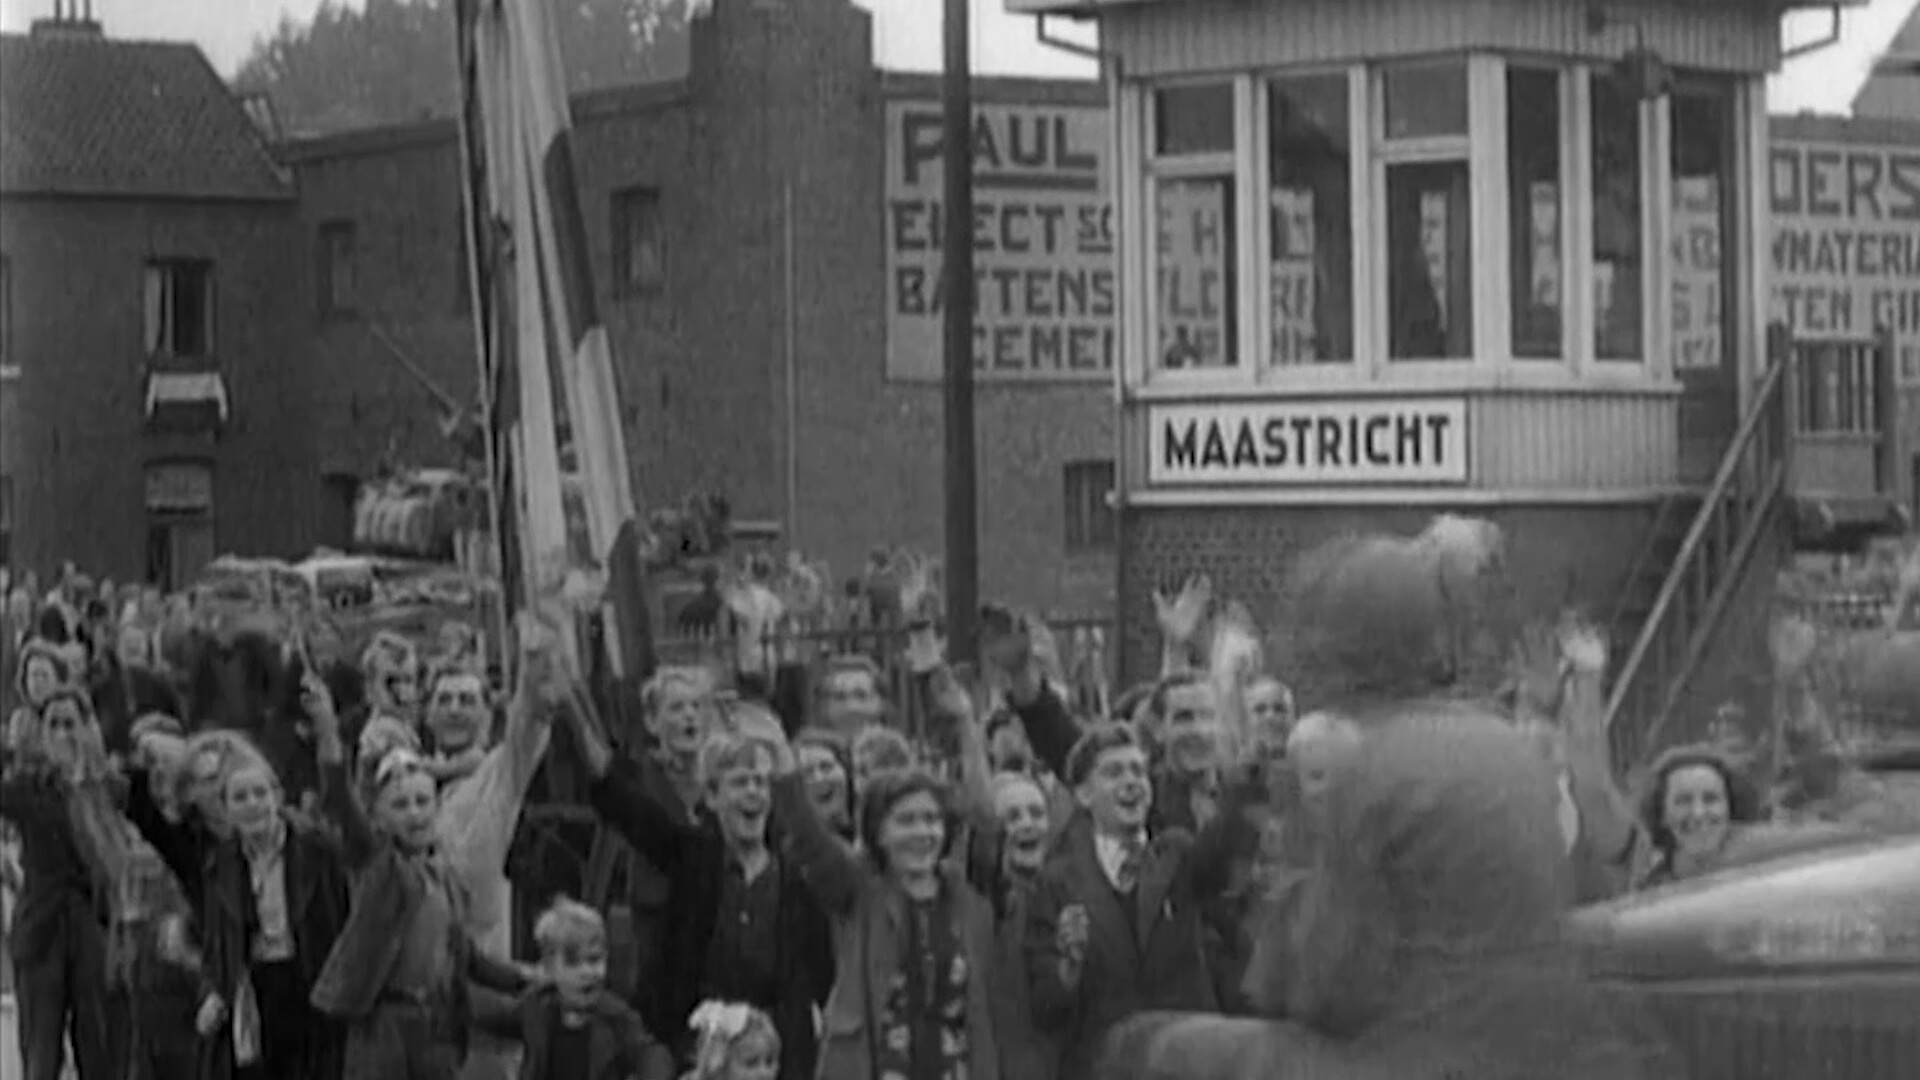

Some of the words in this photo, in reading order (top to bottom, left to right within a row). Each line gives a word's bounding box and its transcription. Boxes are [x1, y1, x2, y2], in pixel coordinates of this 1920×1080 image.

[902, 112, 1098, 186] PAUL
[895, 266, 1114, 317] BTENS
[1163, 413, 1450, 471] MAASTRICHT
